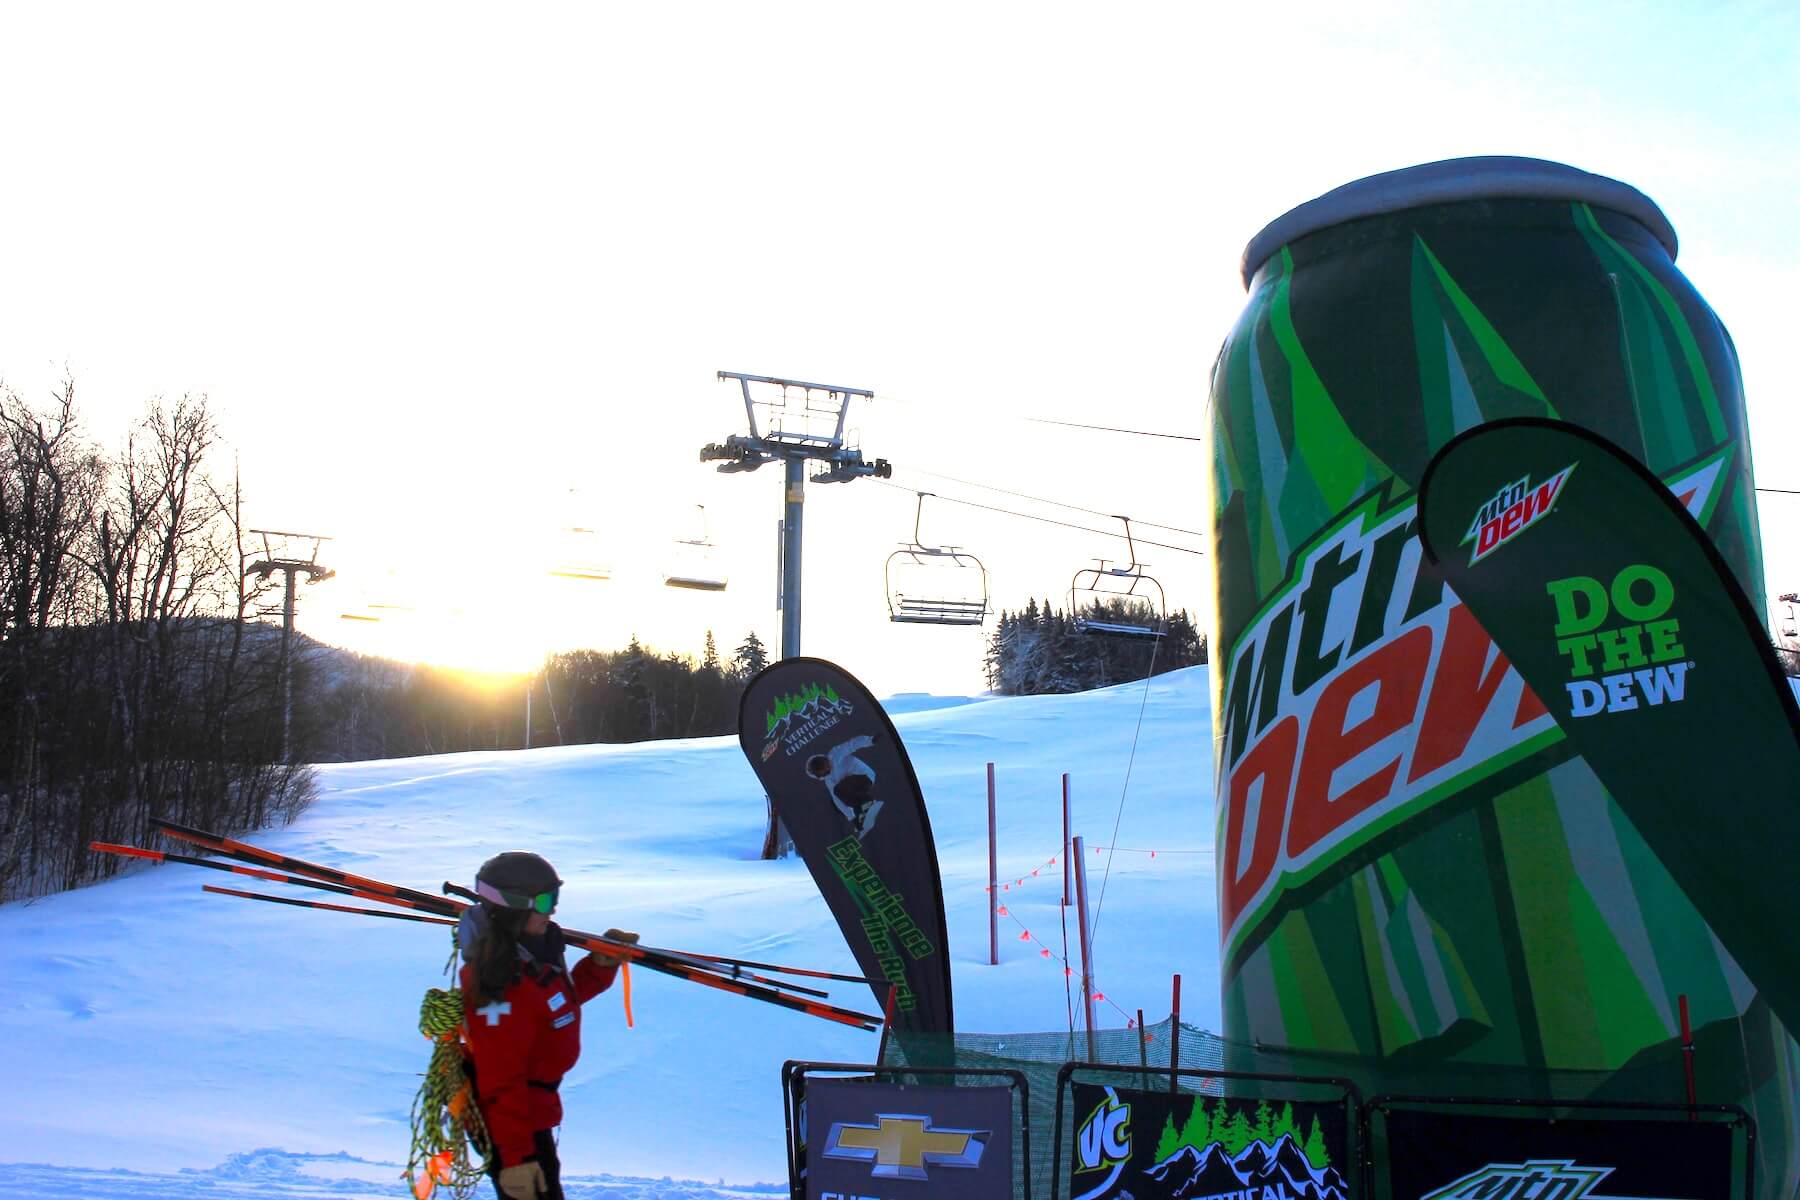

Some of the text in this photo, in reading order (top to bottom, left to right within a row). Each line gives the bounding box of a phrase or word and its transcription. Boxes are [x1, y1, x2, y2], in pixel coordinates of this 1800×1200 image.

[1546, 564, 1675, 636] DO
[1557, 618, 1685, 677] THE
[785, 711, 832, 744] VERTICAL
[786, 715, 841, 757] CHALLENGE
[827, 836, 935, 960] Experience
[861, 912, 890, 954] The
